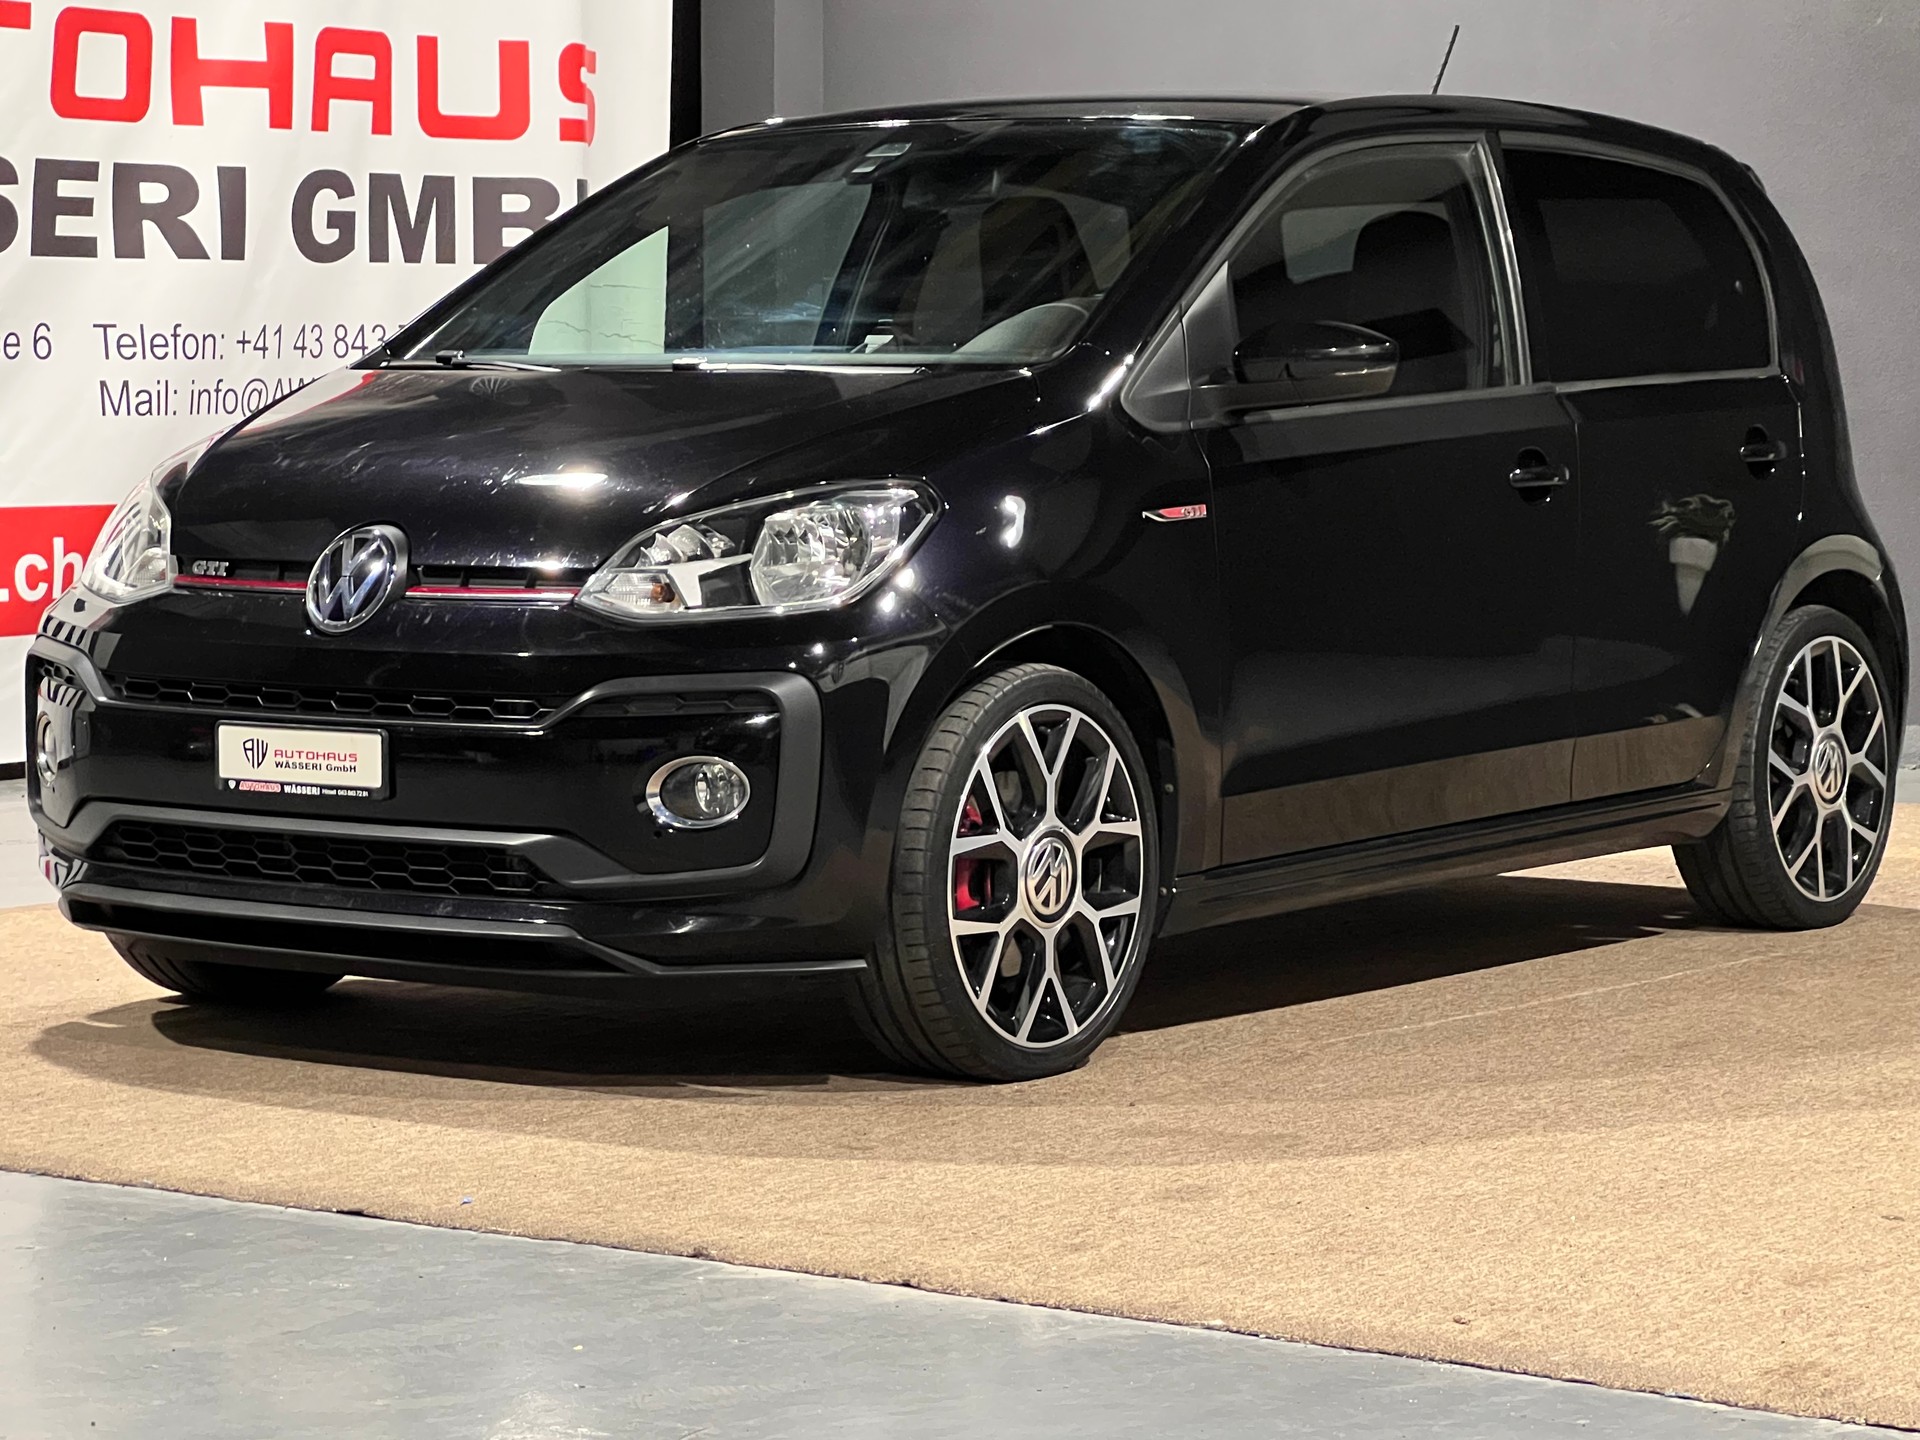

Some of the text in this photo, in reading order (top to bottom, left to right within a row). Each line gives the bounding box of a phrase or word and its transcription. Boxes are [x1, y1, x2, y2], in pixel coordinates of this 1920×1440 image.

[0, 156, 588, 265] ERI GMB
[33, 322, 52, 361] 6
[92, 323, 225, 361] Telefon:
[236, 324, 283, 360] +41
[293, 323, 324, 359] 43
[99, 379, 178, 417] Mail:
[192, 560, 229, 577] GTI
[274, 749, 358, 763] AUTOHAUS
[325, 764, 357, 773] GmbH
